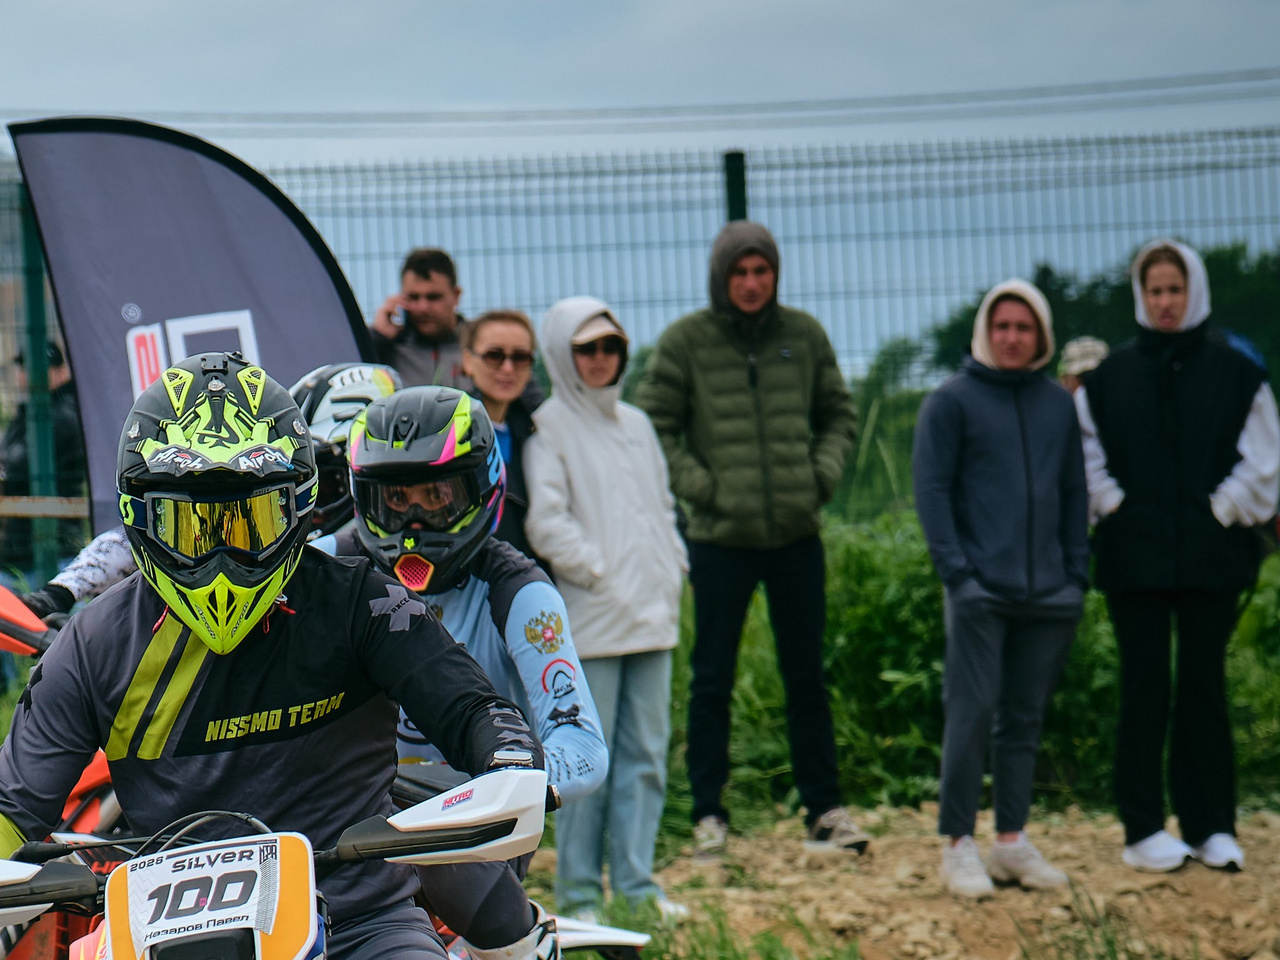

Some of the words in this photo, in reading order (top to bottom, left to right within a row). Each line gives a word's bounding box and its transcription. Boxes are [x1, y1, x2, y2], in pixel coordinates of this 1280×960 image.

[205, 708, 281, 742] NISSMO
[288, 691, 346, 728] TEAM
[147, 869, 258, 925] 100
[144, 922, 203, 942] Назаров
[206, 914, 250, 928] Павел
